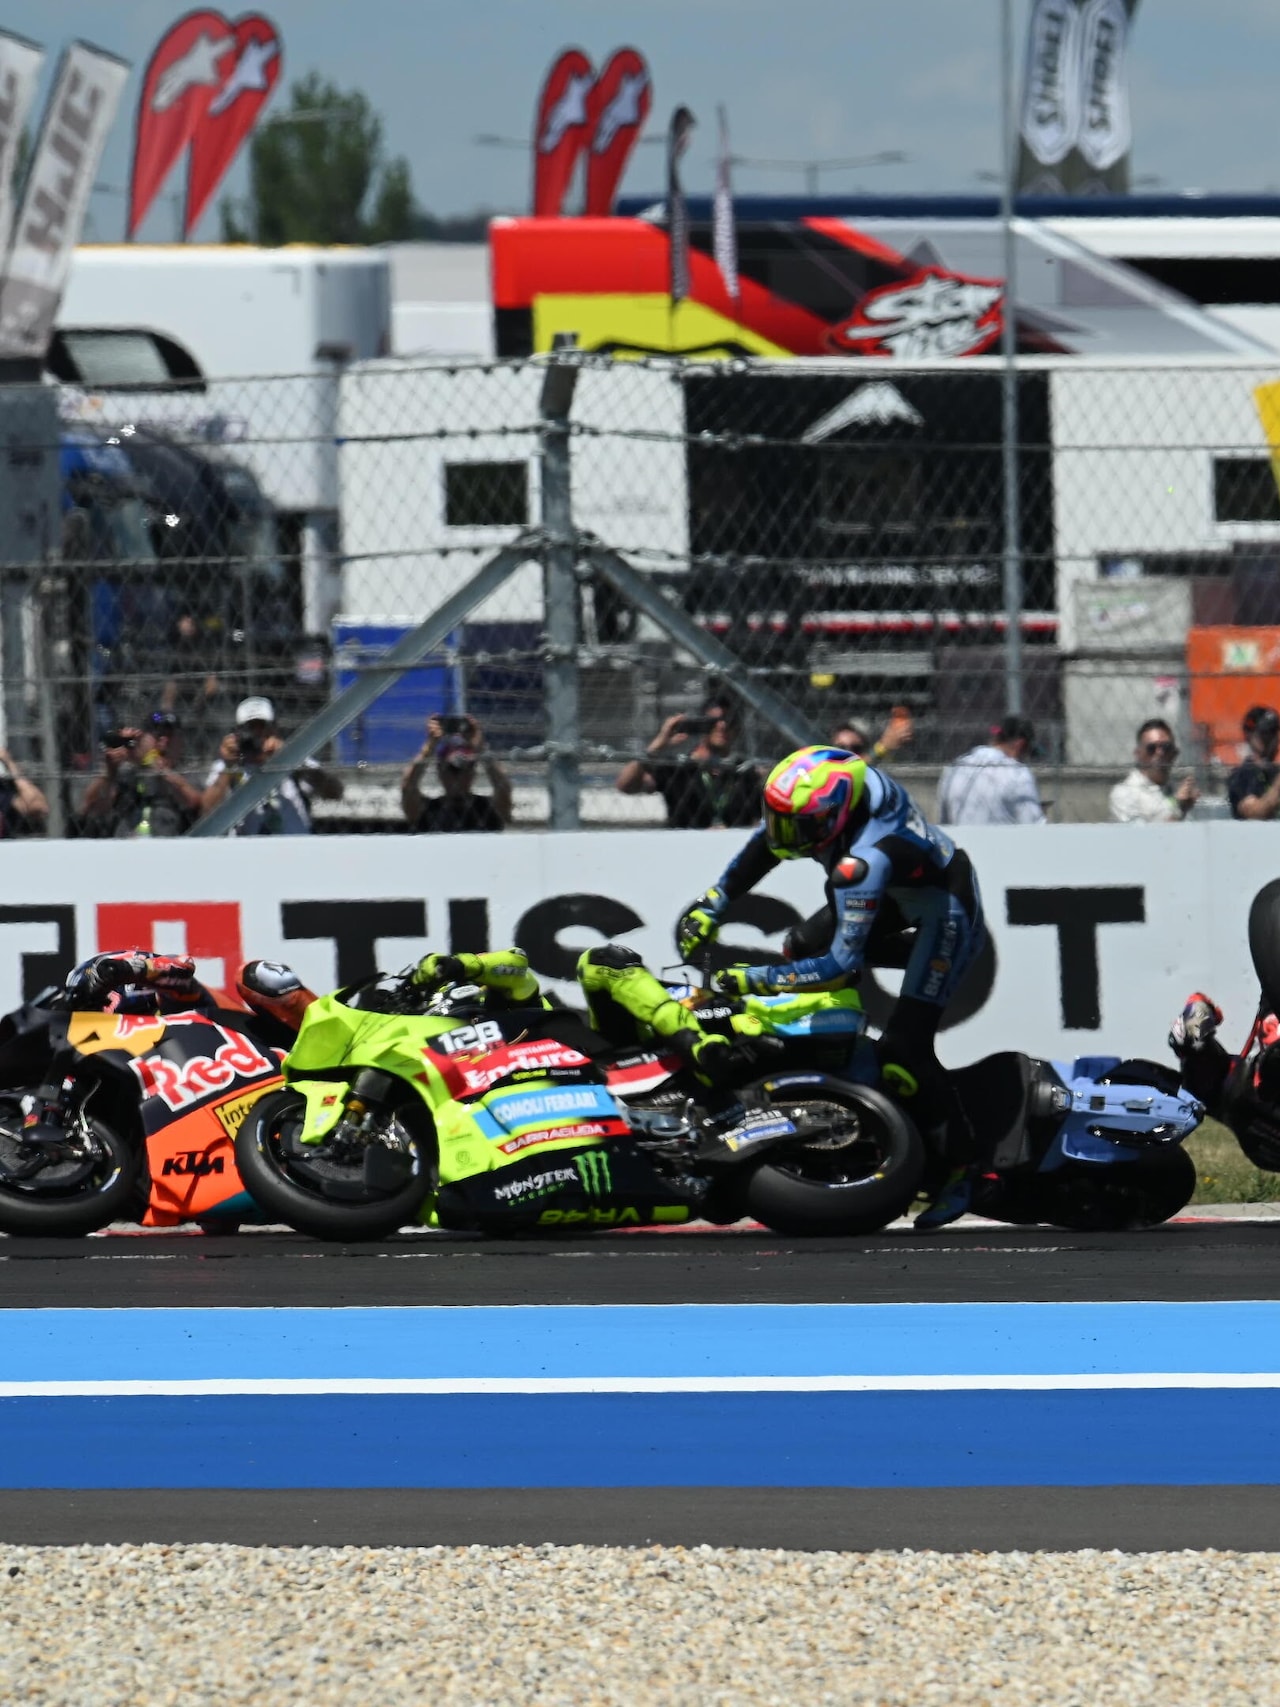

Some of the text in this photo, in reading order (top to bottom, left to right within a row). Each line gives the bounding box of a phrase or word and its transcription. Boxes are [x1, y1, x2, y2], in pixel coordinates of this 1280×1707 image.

[23, 60, 109, 254] HJC
[127, 1020, 274, 1112] Red
[464, 1049, 585, 1090] Enduro
[493, 1091, 598, 1124] COMOLI FERRARI
[504, 1124, 605, 1153] BARRACUDA
[162, 1151, 225, 1177] KTM
